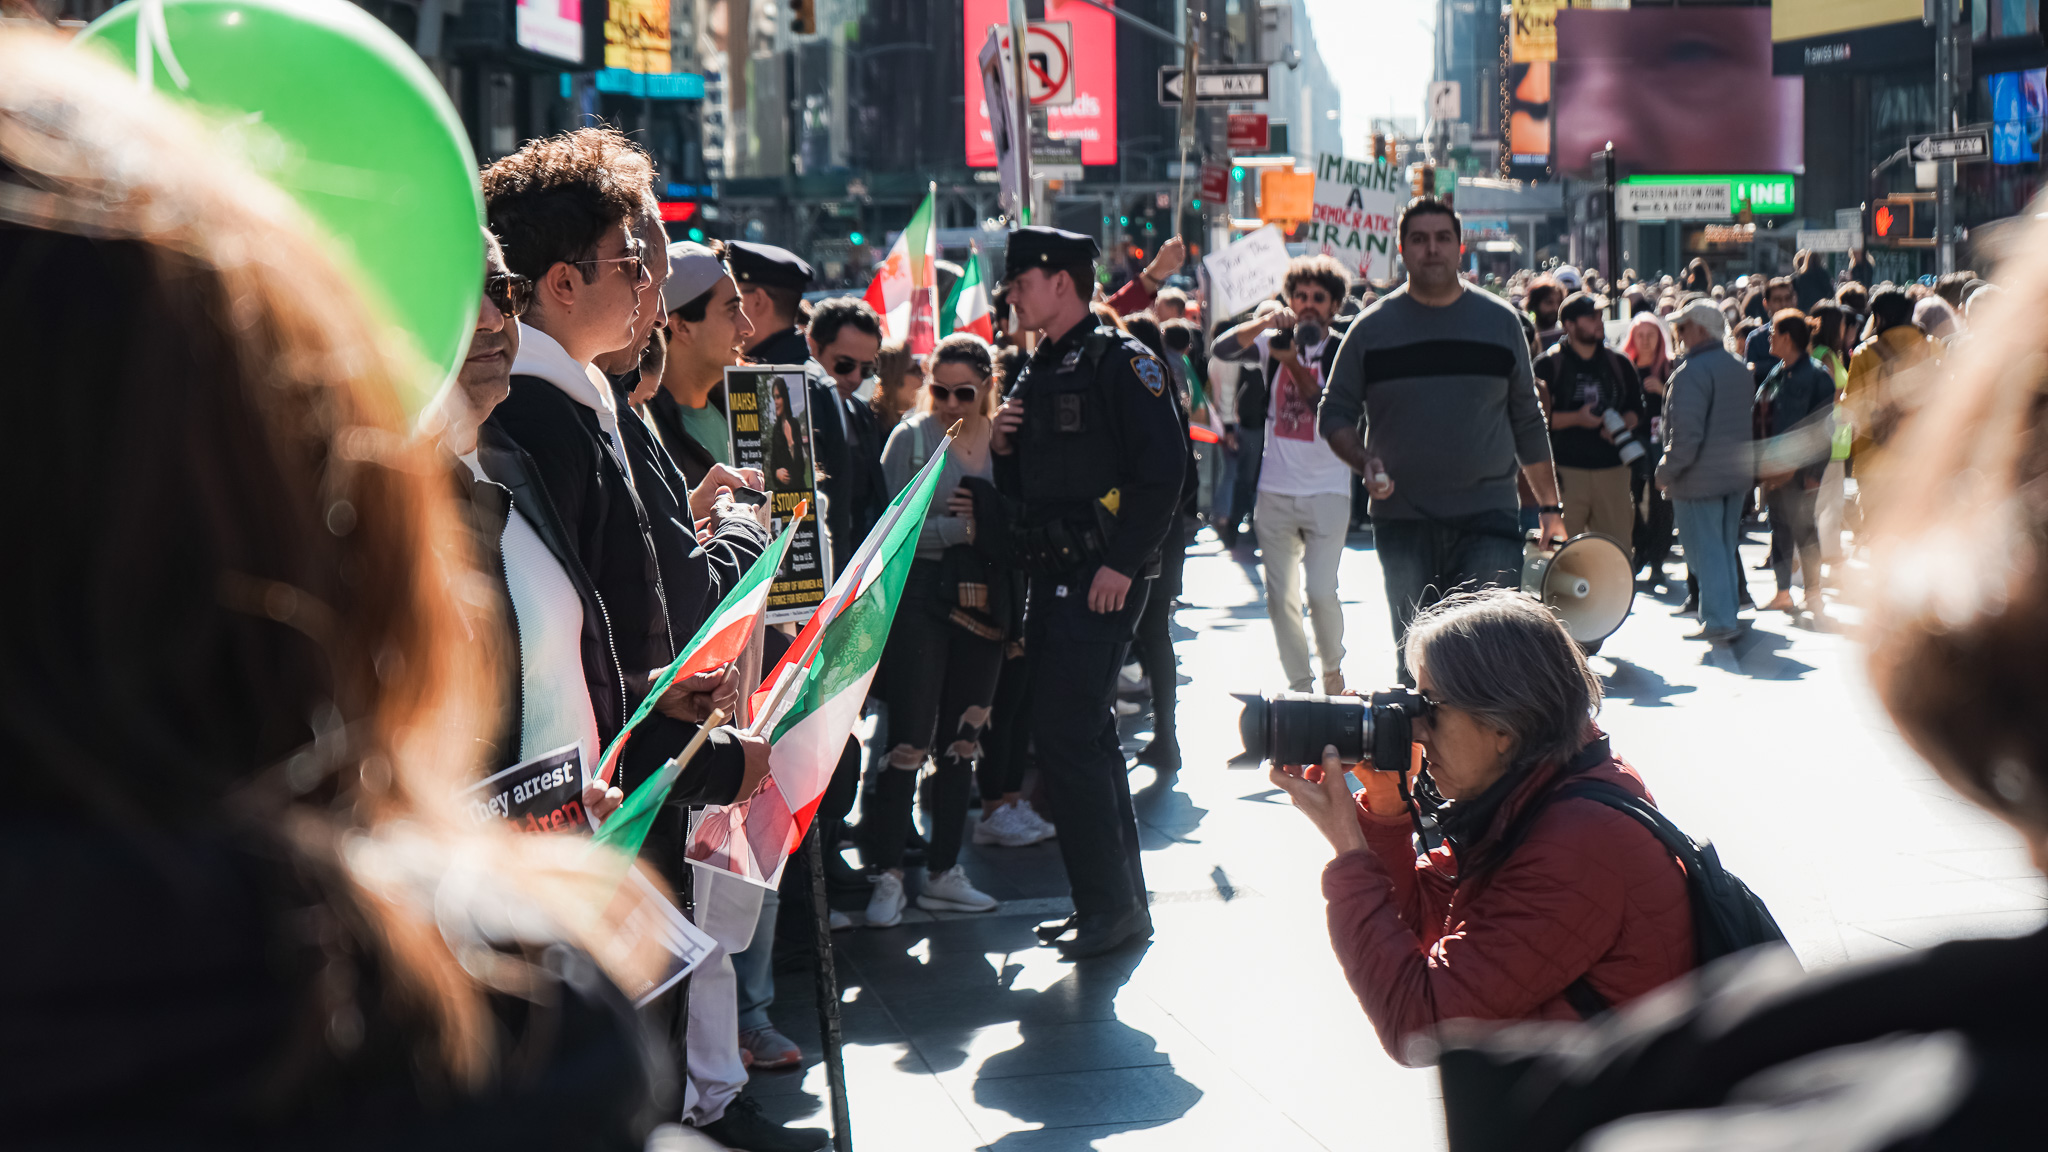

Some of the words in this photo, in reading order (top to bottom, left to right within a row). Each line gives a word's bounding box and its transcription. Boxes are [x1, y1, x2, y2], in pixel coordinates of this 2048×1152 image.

[1222, 76, 1254, 91] WAY
[1921, 143, 1942, 154] ONE
[1954, 138, 1977, 152] WAY
[1318, 153, 1398, 194] IMAGINE
[1346, 188, 1363, 210] A
[1629, 185, 1678, 199] PEDESTRIAN
[1681, 186, 1702, 198] FLOW
[1705, 186, 1725, 197] ZONE
[1312, 203, 1392, 232] DEMOCRATIC
[1309, 222, 1388, 254] IRAN
[729, 392, 758, 411] MAHSA
[736, 414, 759, 432] AMINI
[737, 439, 761, 447] Murdered
[741, 451, 749, 460] by
[749, 450, 762, 458] Iran's
[776, 493, 800, 511] STOOD
[513, 762, 574, 804] arrest
